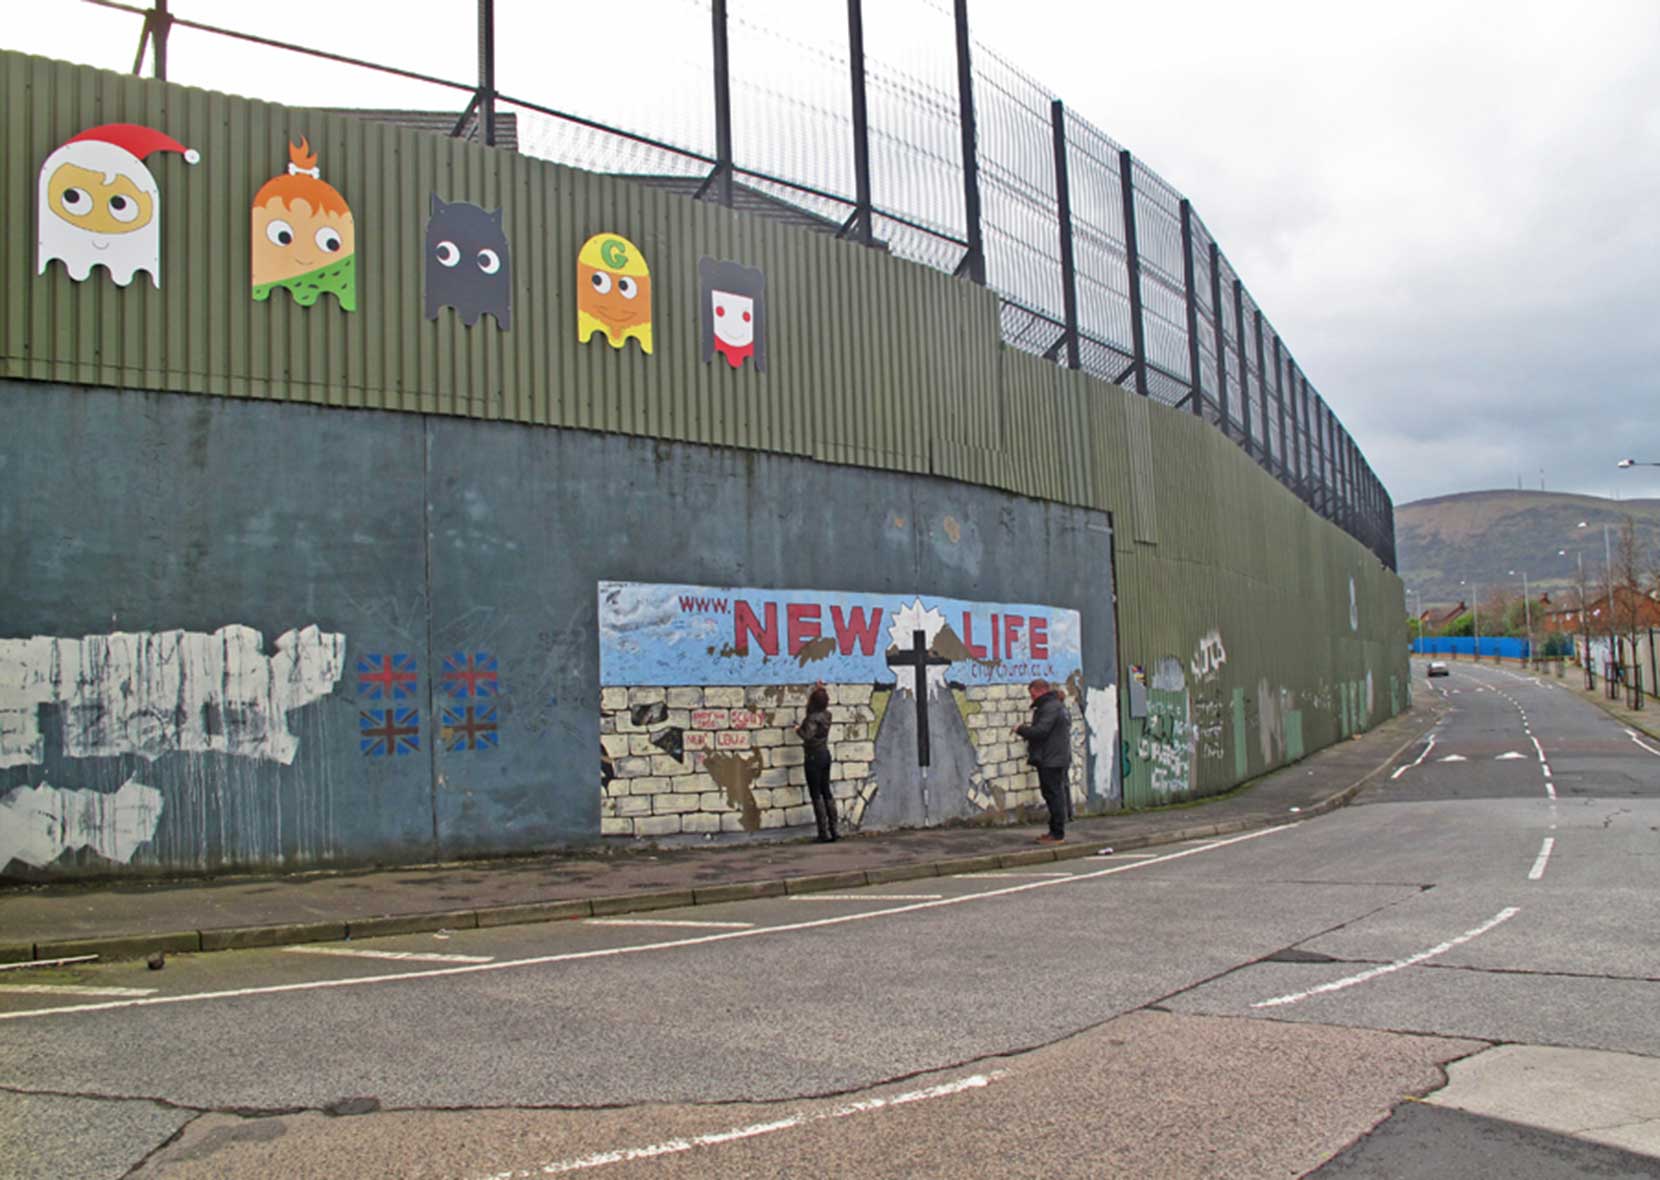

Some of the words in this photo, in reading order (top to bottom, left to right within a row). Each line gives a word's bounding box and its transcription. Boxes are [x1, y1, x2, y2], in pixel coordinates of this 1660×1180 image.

[600, 239, 629, 270] G
[733, 600, 884, 656] NEW
[962, 611, 1049, 660] LIFE
